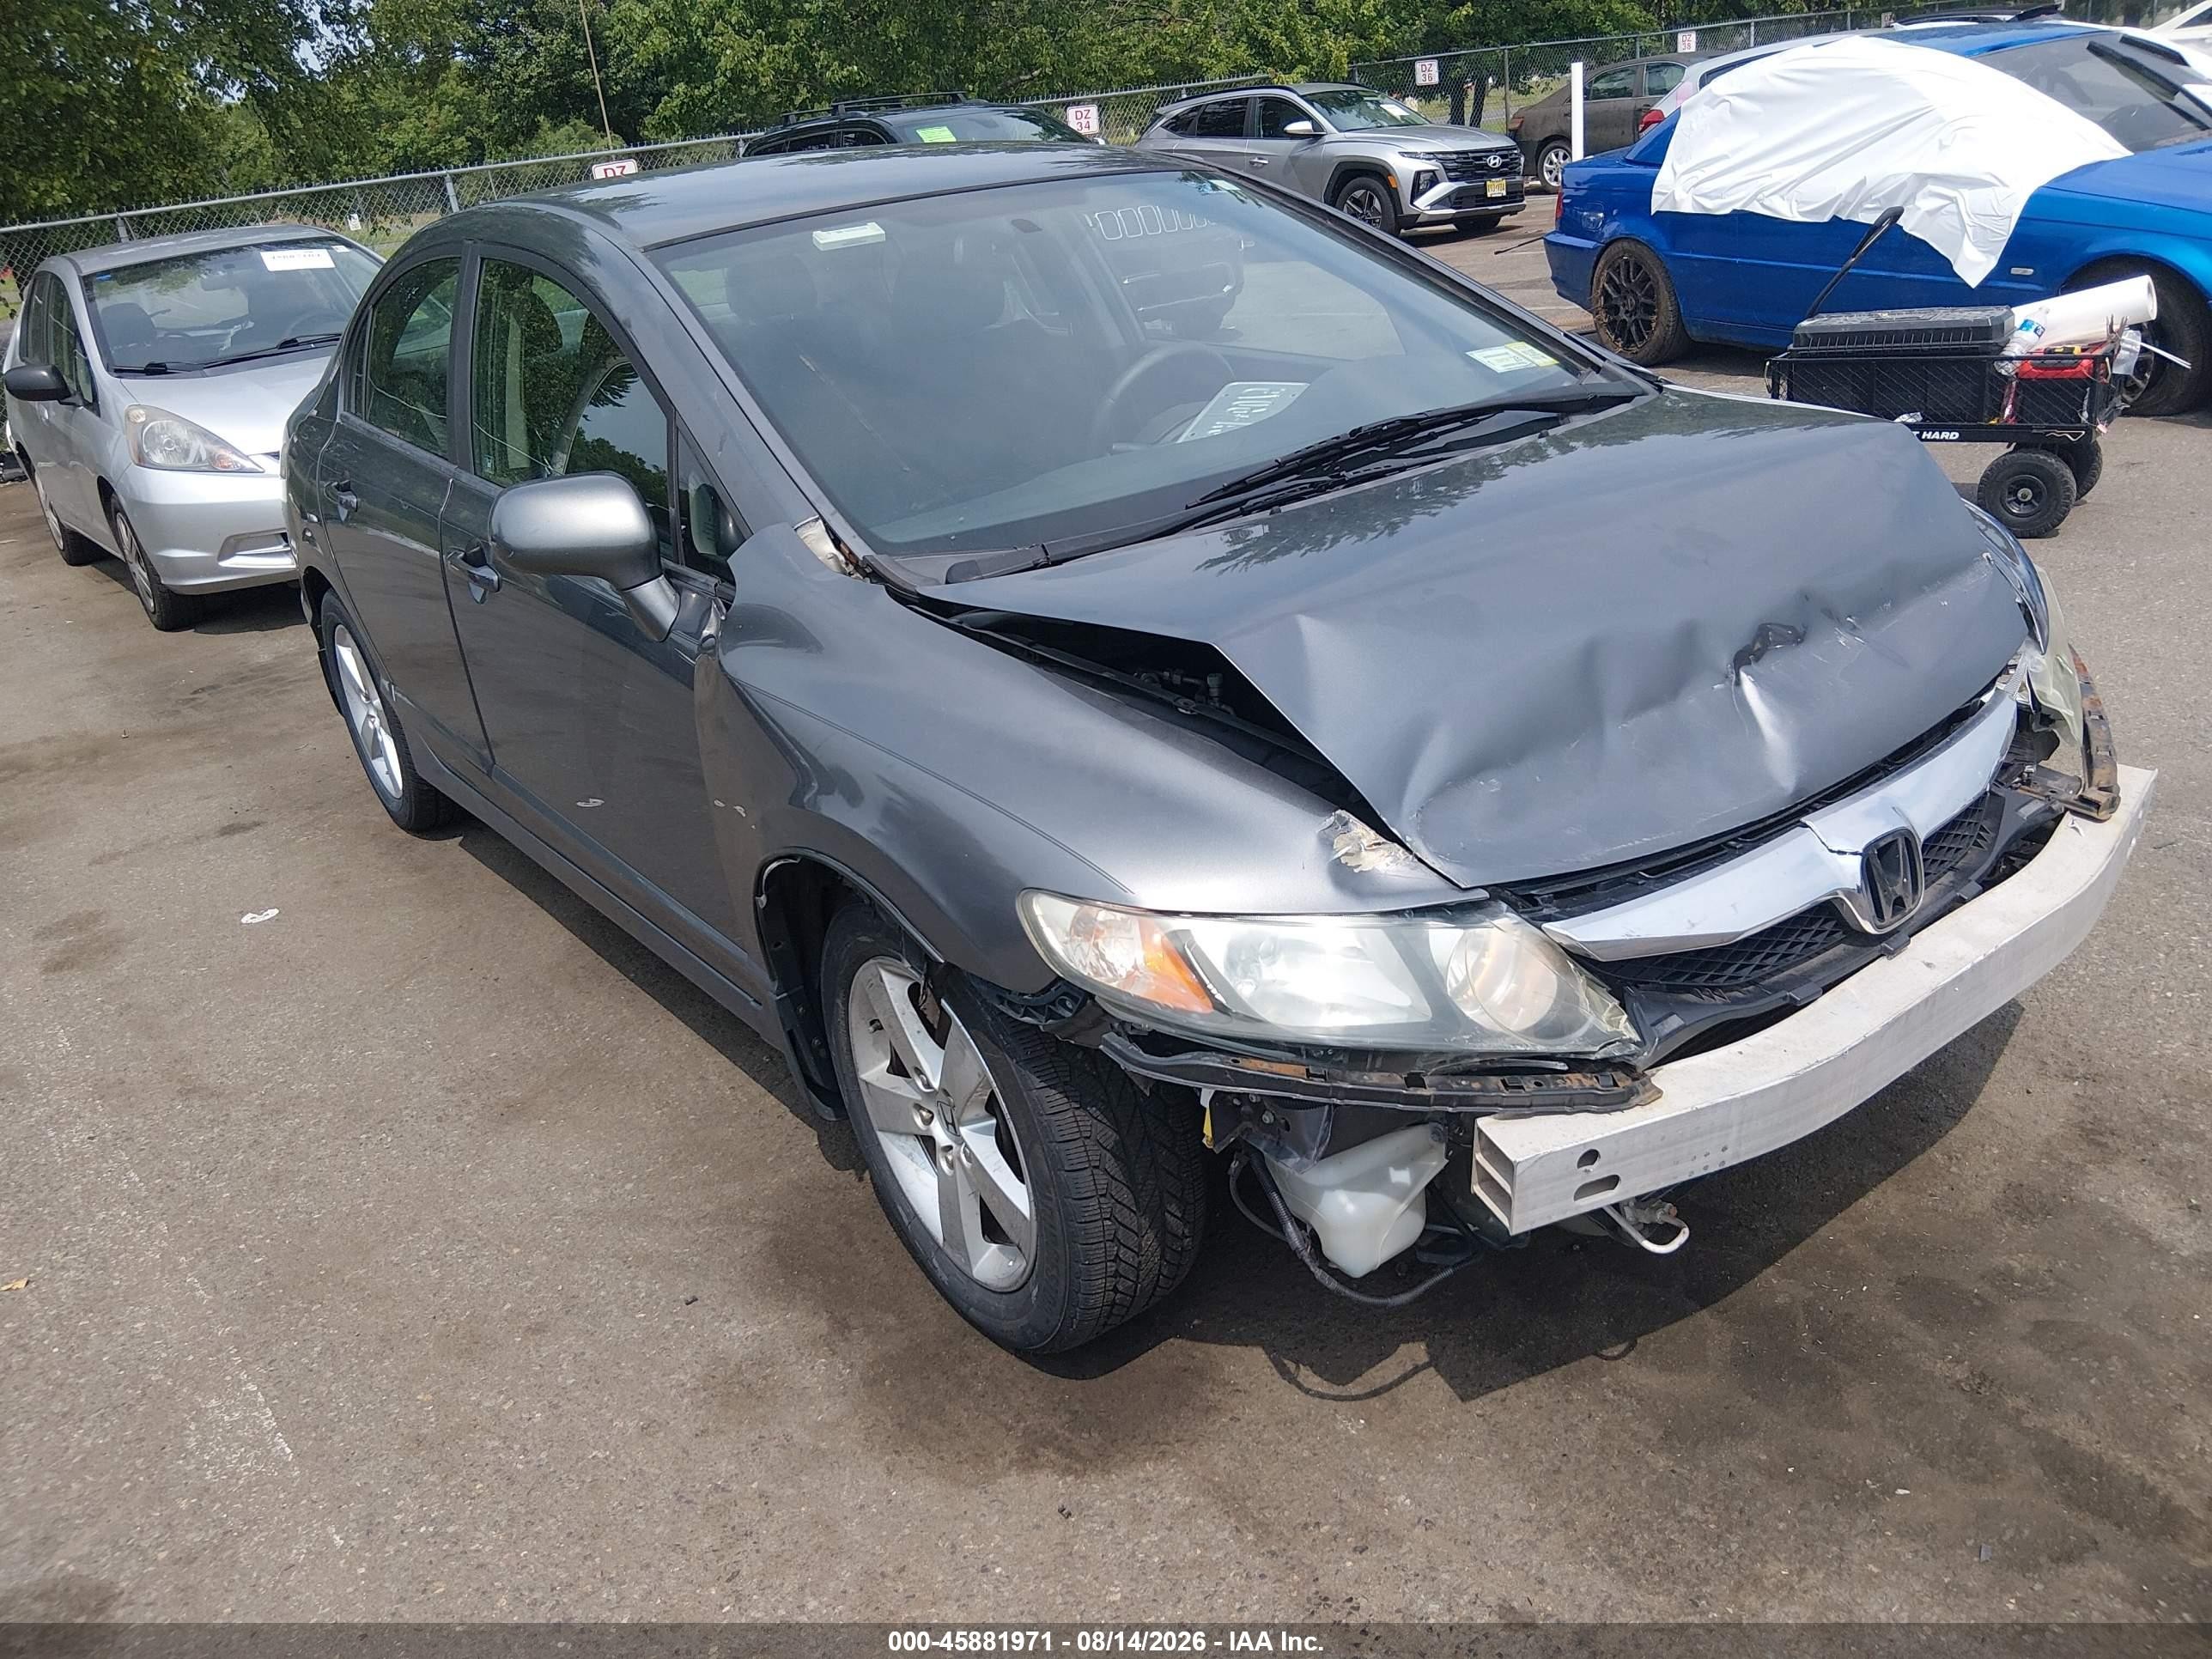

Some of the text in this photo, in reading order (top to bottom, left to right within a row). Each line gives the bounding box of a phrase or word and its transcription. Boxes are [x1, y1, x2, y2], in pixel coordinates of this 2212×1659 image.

[1682, 33, 1692, 42] DZ
[1421, 63, 1432, 73] DZ
[1422, 73, 1433, 82] 36
[1075, 109, 1091, 120] DZ
[1076, 120, 1091, 131] 34
[604, 165, 625, 178] DZ
[1922, 431, 1960, 440] HARD
